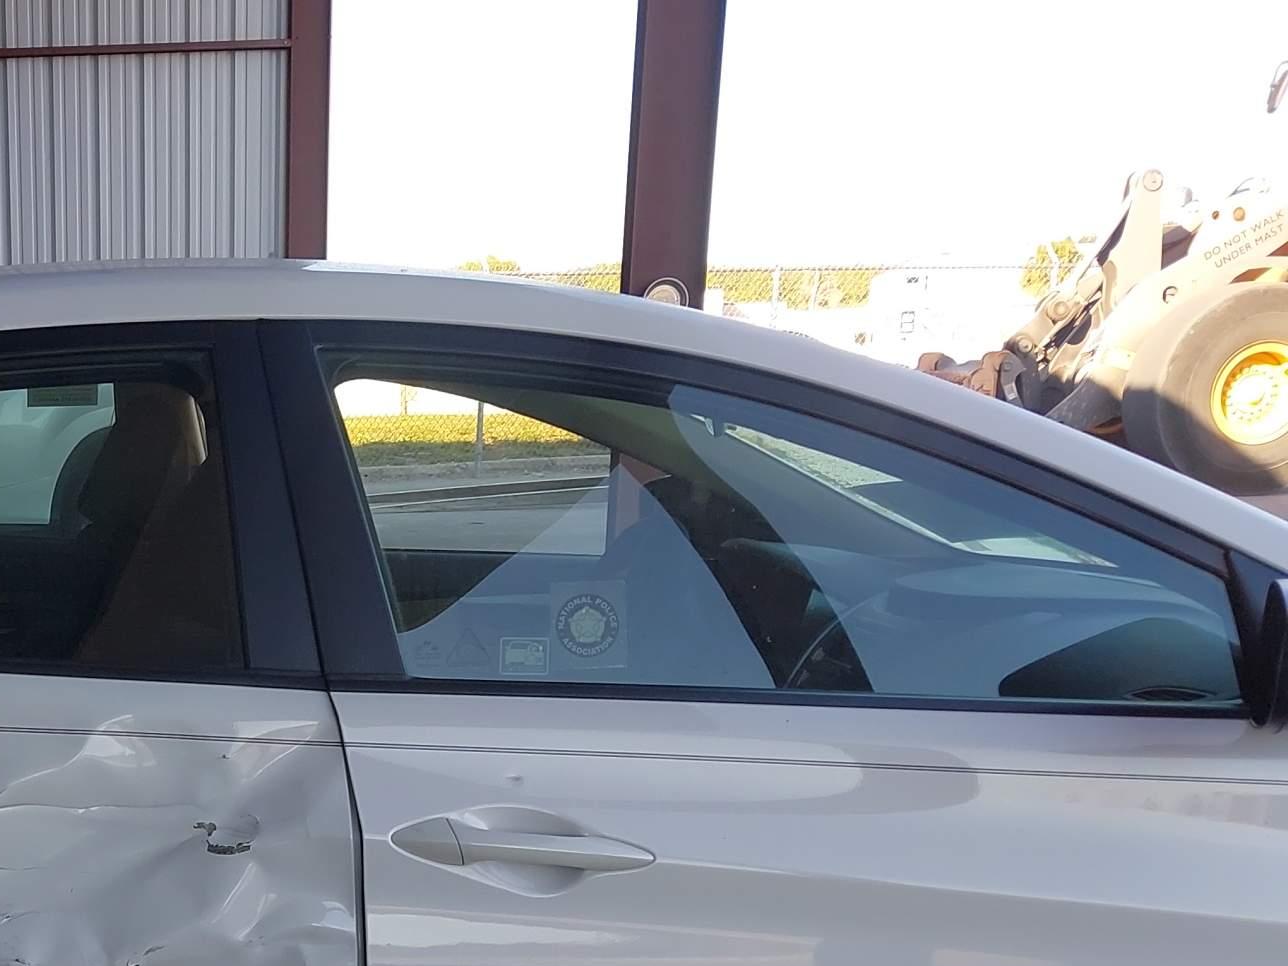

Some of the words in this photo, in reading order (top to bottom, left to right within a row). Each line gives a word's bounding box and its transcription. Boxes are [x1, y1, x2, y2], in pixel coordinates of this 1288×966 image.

[1203, 246, 1221, 261] DO
[1224, 230, 1247, 248] NOT
[1250, 209, 1284, 232] WALK
[1214, 242, 1252, 268] UNDER
[1254, 223, 1284, 246] MAST
[558, 596, 593, 629] NATIONAL
[594, 598, 618, 629] POLICE
[562, 636, 614, 655] ASSOCIATION
